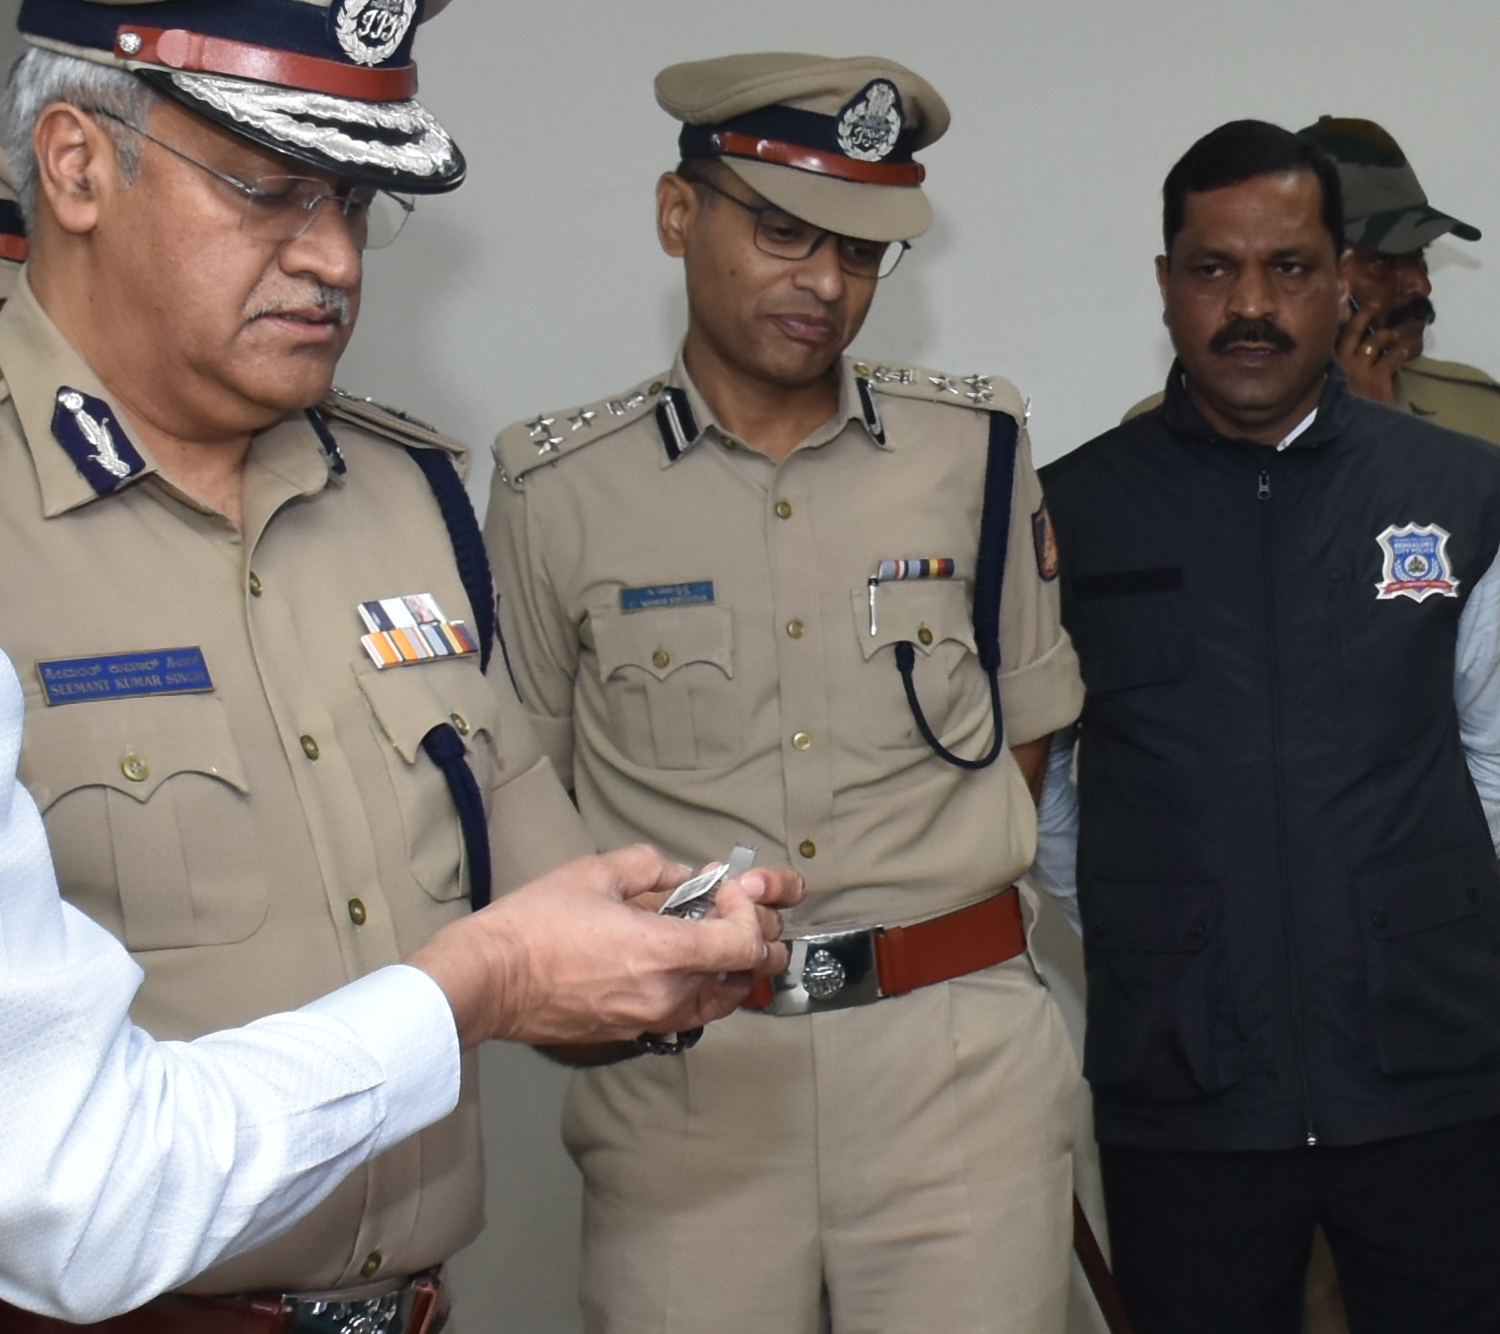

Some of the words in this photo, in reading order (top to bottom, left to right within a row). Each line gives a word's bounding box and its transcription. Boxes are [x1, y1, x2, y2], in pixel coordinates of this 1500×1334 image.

[51, 679, 111, 697] SEEMANT
[115, 674, 162, 690] KUMAR
[166, 670, 207, 686] SINGH
